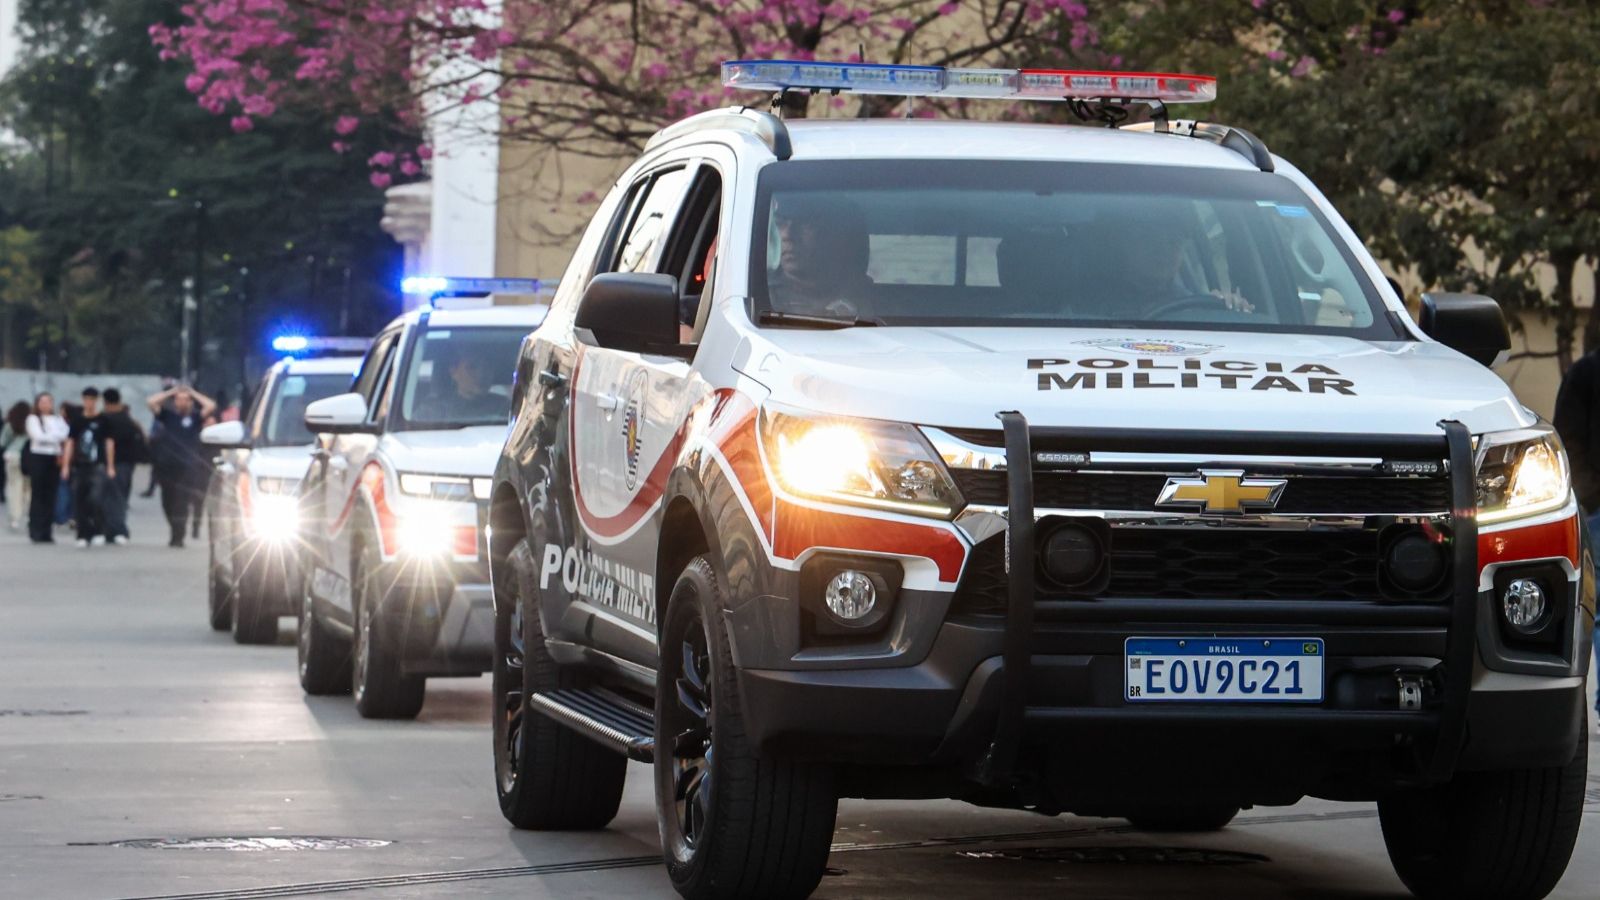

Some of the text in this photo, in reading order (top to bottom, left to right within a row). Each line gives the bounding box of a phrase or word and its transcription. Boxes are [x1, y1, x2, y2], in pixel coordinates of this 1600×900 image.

[1037, 372, 1357, 396] MILITAR
[616, 563, 657, 625] MILIT
[1208, 645, 1240, 654] BRASIL
[1129, 685, 1141, 697] BR
